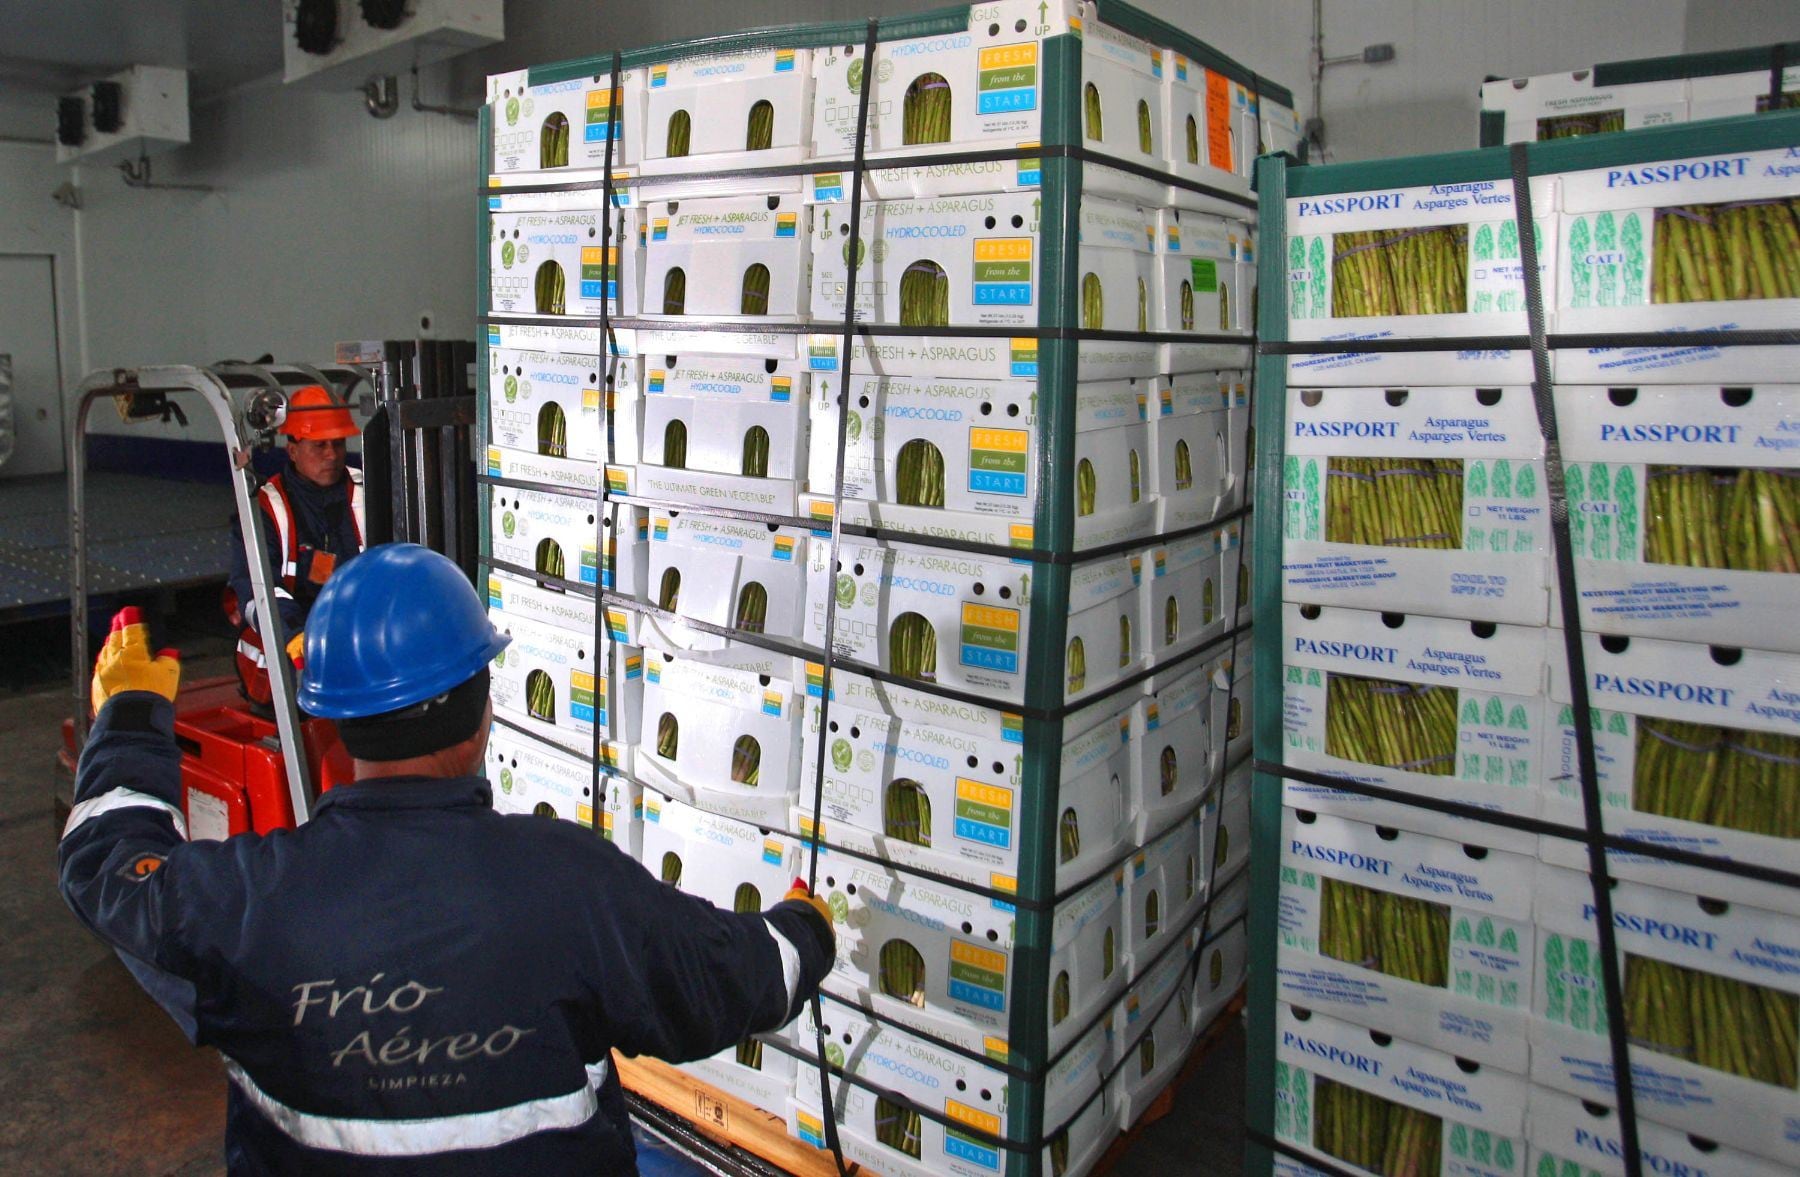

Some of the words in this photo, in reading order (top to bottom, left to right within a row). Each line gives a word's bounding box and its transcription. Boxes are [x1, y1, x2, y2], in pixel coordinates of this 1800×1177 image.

[1034, 25, 1051, 37] UP
[891, 36, 972, 58] HYDRO-COOLED
[824, 56, 837, 67] UP
[984, 49, 1033, 65] FRESH
[989, 73, 1010, 87] from
[1012, 72, 1026, 82] the
[983, 93, 1032, 109] START
[925, 161, 1004, 179] ASPARAGUS
[1607, 157, 1751, 188] PASSPORT
[1429, 181, 1495, 196] Asparagus
[864, 205, 880, 220] JET
[881, 202, 914, 216] FRESH
[927, 198, 995, 214] ASPARAGUS
[1299, 193, 1405, 217] PASSPORT
[1413, 198, 1469, 211] Asparges
[1472, 192, 1511, 205] Vertes
[516, 217, 527, 227] JET
[527, 215, 547, 226] FRESH
[556, 214, 597, 226] ASPARAGUS
[676, 214, 690, 227] JET
[690, 213, 712, 225] FRESH
[720, 211, 769, 224] ASPARAGUS
[692, 224, 745, 236] HYDRO-COOLED
[820, 230, 833, 241] UP
[886, 224, 967, 239] HYDRO-COOLED
[527, 233, 578, 245] HYDRO-COOLED
[978, 244, 1028, 257] FRESH
[1585, 253, 1616, 266] CAT
[984, 267, 1003, 277] from
[1004, 266, 1021, 276] the
[979, 288, 1025, 299] START
[520, 326, 542, 338] FRESH
[527, 353, 548, 364] FRESH
[554, 354, 598, 369] ASPARAGUS
[850, 345, 867, 361] JET
[869, 345, 905, 359] FRESH
[920, 346, 997, 362] ASPARAGUS
[530, 372, 579, 386] HYDRO-COOLED
[617, 380, 629, 390] UP
[673, 370, 686, 381] JET
[687, 370, 709, 381] FRESH
[717, 371, 764, 384] ASPARAGUS
[690, 382, 742, 395] HYDRO-COOLED
[860, 381, 878, 396] JET
[879, 381, 912, 395] FRESH
[925, 384, 991, 401] ASPARAGUS
[817, 402, 830, 412] UP
[882, 406, 963, 422] HYDRO-COOLED
[1295, 421, 1400, 438] PASSPORT
[1425, 416, 1489, 429] Asparagus
[974, 432, 1024, 447] FRESH
[1408, 430, 1463, 443] Asparges
[1468, 430, 1506, 443] Vertes
[1600, 423, 1742, 444] PASSPORT
[980, 454, 999, 467] from
[1000, 456, 1017, 467] the
[509, 462, 519, 473] JET
[520, 465, 542, 477] FRESH
[550, 472, 598, 487] ASPARAGUS
[975, 475, 1021, 491] START
[663, 482, 698, 495] ULTIMATE
[699, 486, 728, 499] GREEN
[1505, 505, 1540, 515] WEIGHT
[1580, 502, 1612, 513] CAT
[676, 519, 689, 530] JET
[690, 521, 711, 533] FRESH
[720, 525, 767, 541] ASPARAGUS
[915, 526, 996, 546] ASPARAGUS
[692, 534, 744, 549] HYDRO-COOLED
[813, 563, 826, 574] UP
[855, 548, 871, 562] JET
[872, 550, 906, 564] FRESH
[919, 556, 984, 577] ASPARAGUS
[876, 575, 956, 597] HYDRO-COOLED
[520, 598, 544, 610] FRESH
[1016, 595, 1031, 607] UP
[966, 607, 1015, 624] FRESH
[971, 631, 992, 643] from
[993, 633, 1008, 644] the
[1295, 637, 1399, 664] PASSPORT
[1423, 646, 1487, 665] Asparagus
[965, 650, 1012, 669] START
[1406, 659, 1460, 678] Asparges
[1464, 665, 1502, 680] Vertes
[1595, 673, 1735, 707] PASSPORT
[845, 683, 861, 698] JET
[863, 685, 899, 704] FRESH
[913, 699, 989, 724] ASPARAGUS
[854, 713, 869, 727] JET
[911, 727, 978, 754] ASPARAGUS
[1477, 731, 1495, 740] NET
[1496, 732, 1530, 744] WEIGHT
[872, 740, 950, 771] HYDRO-COOLED
[550, 760, 592, 784] ASPARAGUS
[961, 783, 1009, 806] FRESH
[610, 803, 622, 812] UP
[966, 806, 986, 819] from
[987, 808, 1001, 821] the
[710, 820, 757, 842] ASPARAGUS
[959, 822, 1006, 844] START
[1291, 840, 1394, 875] PASSPORT
[1416, 862, 1478, 885] Asparagus
[850, 868, 865, 883] JET
[910, 888, 973, 917] ASPARAGUS
[1401, 873, 1453, 895] Asparges
[1456, 884, 1495, 903] Vertes
[868, 896, 945, 932] HYDRO-COOLED
[1582, 903, 1719, 951] PSSPORT
[954, 945, 1003, 969] FRESH
[958, 968, 979, 982] from
[980, 973, 995, 985] the
[292, 973, 443, 1026] Frío
[954, 983, 999, 1006] START
[330, 1025, 537, 1067] Aéreo
[1284, 1031, 1384, 1077] PASSPORT
[904, 1044, 966, 1078] ASPARAGUS
[864, 1051, 940, 1089] HYDRO-COOLED
[369, 1072, 467, 1090] LIMPIEZA
[1406, 1066, 1468, 1094] Asparagus
[1390, 1074, 1443, 1102] Asparges
[1446, 1091, 1484, 1113] Vertes
[950, 1103, 995, 1130] FRESH
[853, 1143, 885, 1169] FRESH
[949, 1141, 994, 1166] START
